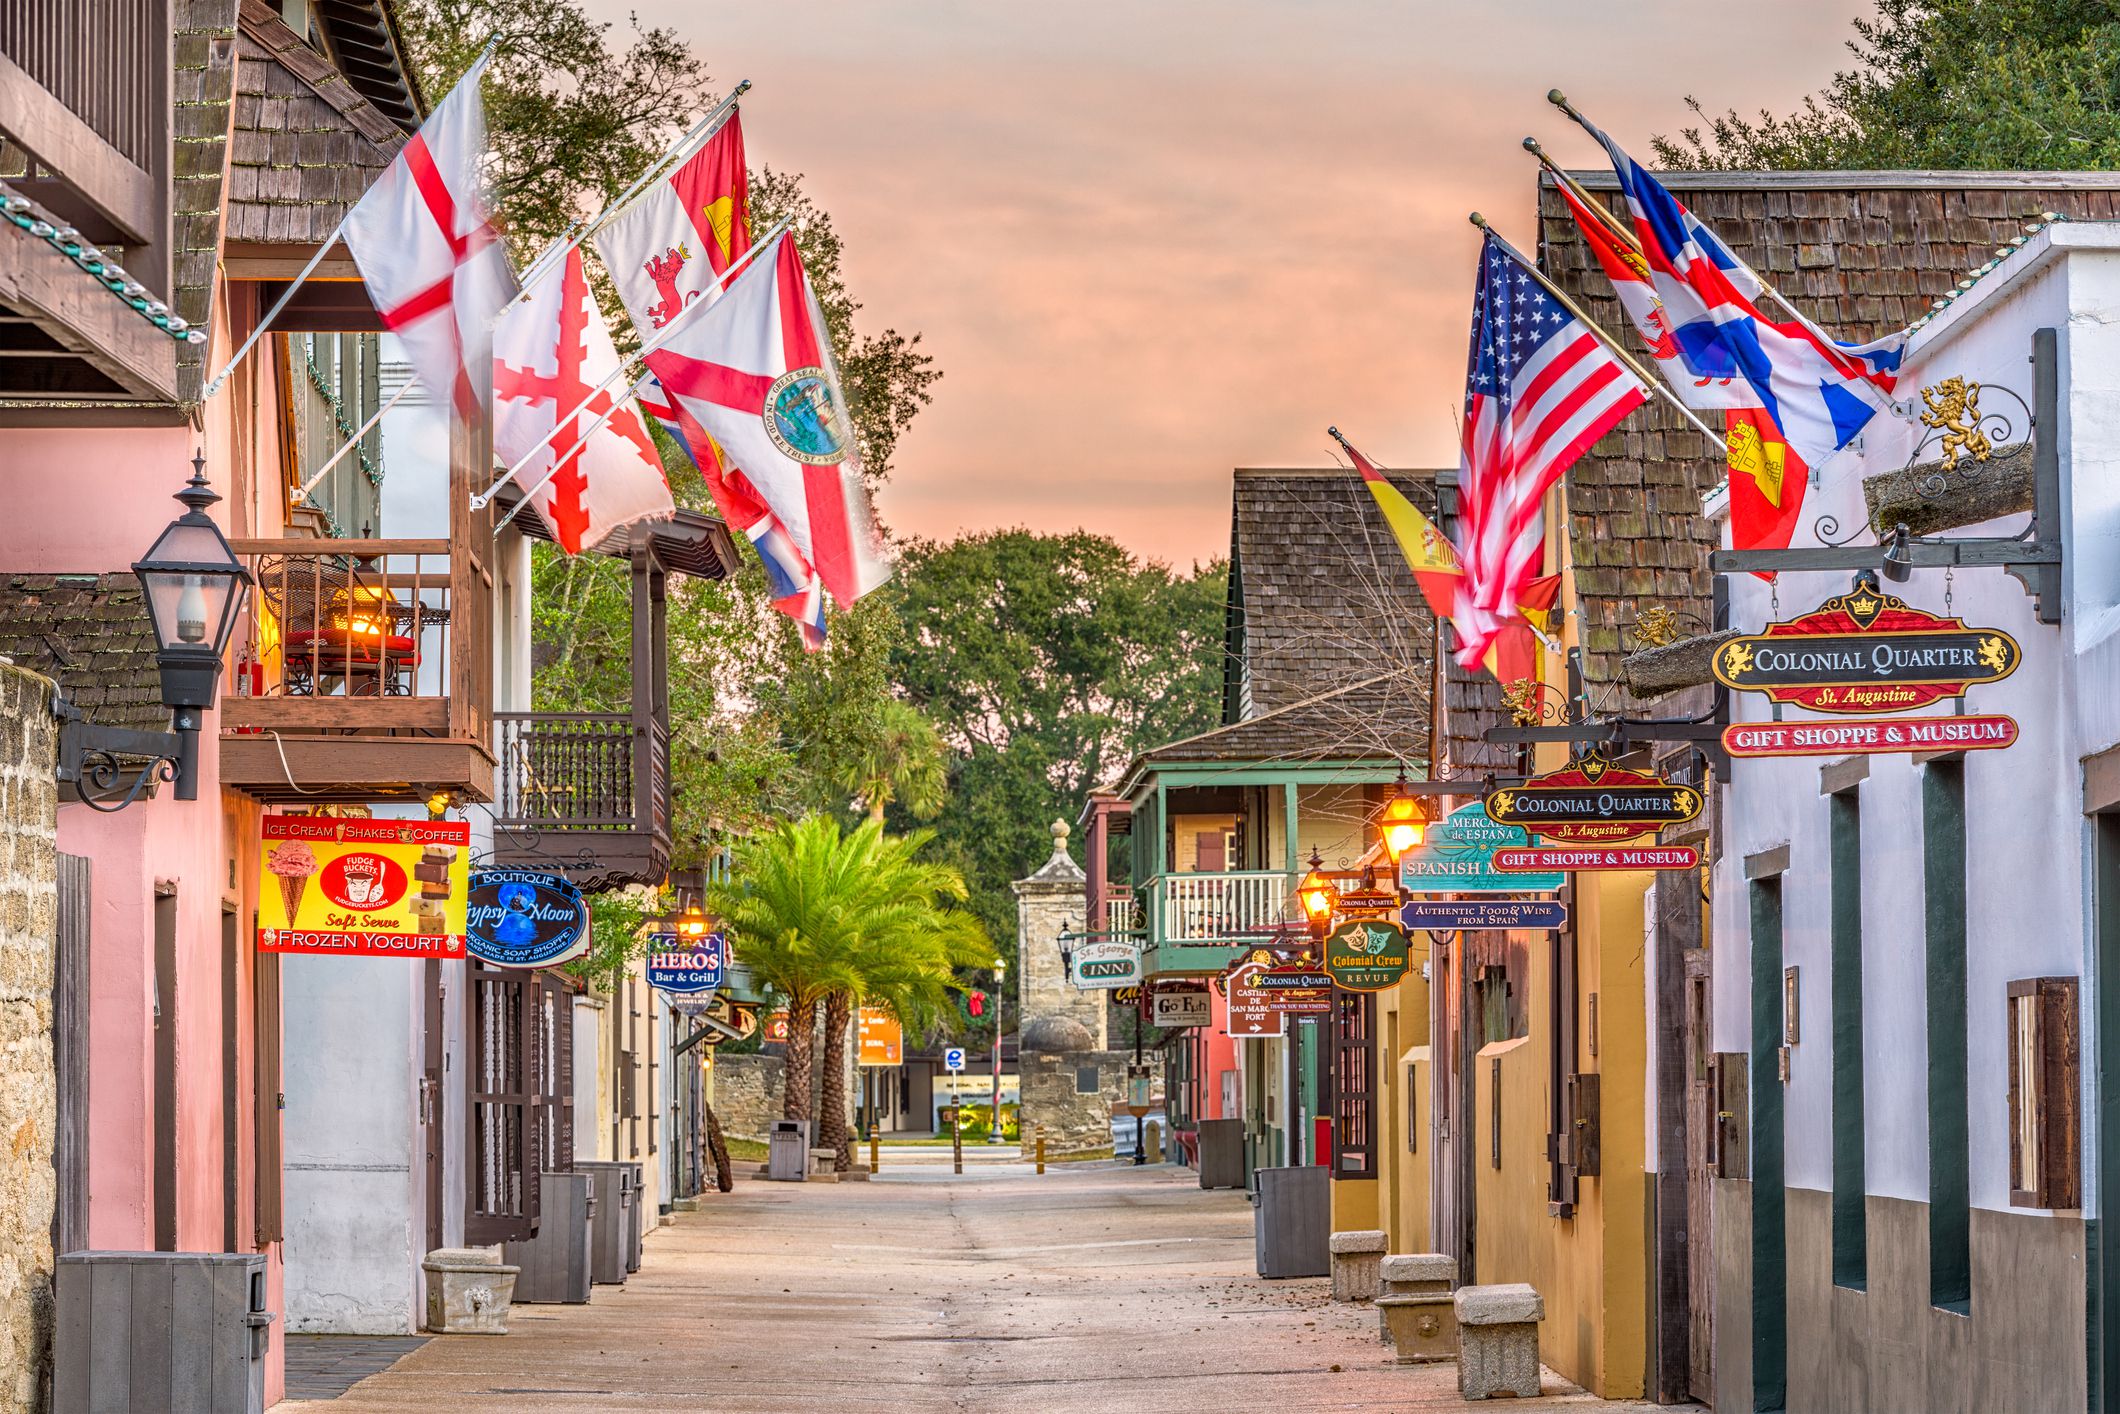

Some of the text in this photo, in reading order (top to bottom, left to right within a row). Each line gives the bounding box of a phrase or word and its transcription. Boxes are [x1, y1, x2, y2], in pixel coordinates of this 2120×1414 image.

[772, 374, 794, 394] GREAT
[766, 403, 773, 413] IN
[766, 415, 777, 434] GOD
[786, 447, 814, 463] TRUST
[1754, 644, 1977, 674] COLONIAL QUARTER
[1816, 686, 1916, 707] St. Augustine
[1736, 723, 2006, 748] GIFT SHOPPE & MUSEUM
[1515, 794, 1672, 816] COLONIAL QUARTER
[1452, 818, 1512, 828] MERCA
[266, 824, 464, 842] ICE CREAM SHAKES COFFEE
[1452, 828, 1514, 840] de ESPAÑA
[1558, 824, 1629, 838] St. Augustine
[346, 857, 375, 866] FUDGE
[1502, 852, 1690, 866] GIFT SHOPPE & MUSEUM
[1406, 863, 1481, 876] SPANISH
[482, 873, 555, 887] BOUTIQUE
[335, 896, 389, 909] FUDGEBUCKETS.COM
[1368, 898, 1394, 908] QUARTER
[528, 903, 574, 921] Moon
[1416, 906, 1552, 916] AUTHENTIC FOOD & WINE
[325, 913, 400, 930] Soft Serve
[1488, 916, 1519, 925] SPAIN
[278, 930, 444, 951] FROZEN YOGURT
[466, 930, 501, 956] ORGANIC
[503, 949, 531, 957] SOAP
[484, 950, 505, 961] MADE
[529, 941, 568, 961] AUGUSTINE
[1080, 944, 1133, 960] St. George
[651, 953, 719, 970] HEROS
[1090, 962, 1125, 975] INN
[1333, 955, 1402, 968] Colonial Crew
[656, 972, 715, 982] Bar & Grill
[1262, 976, 1331, 987] COLONIAL QUARTE
[1347, 974, 1389, 983] REVUE
